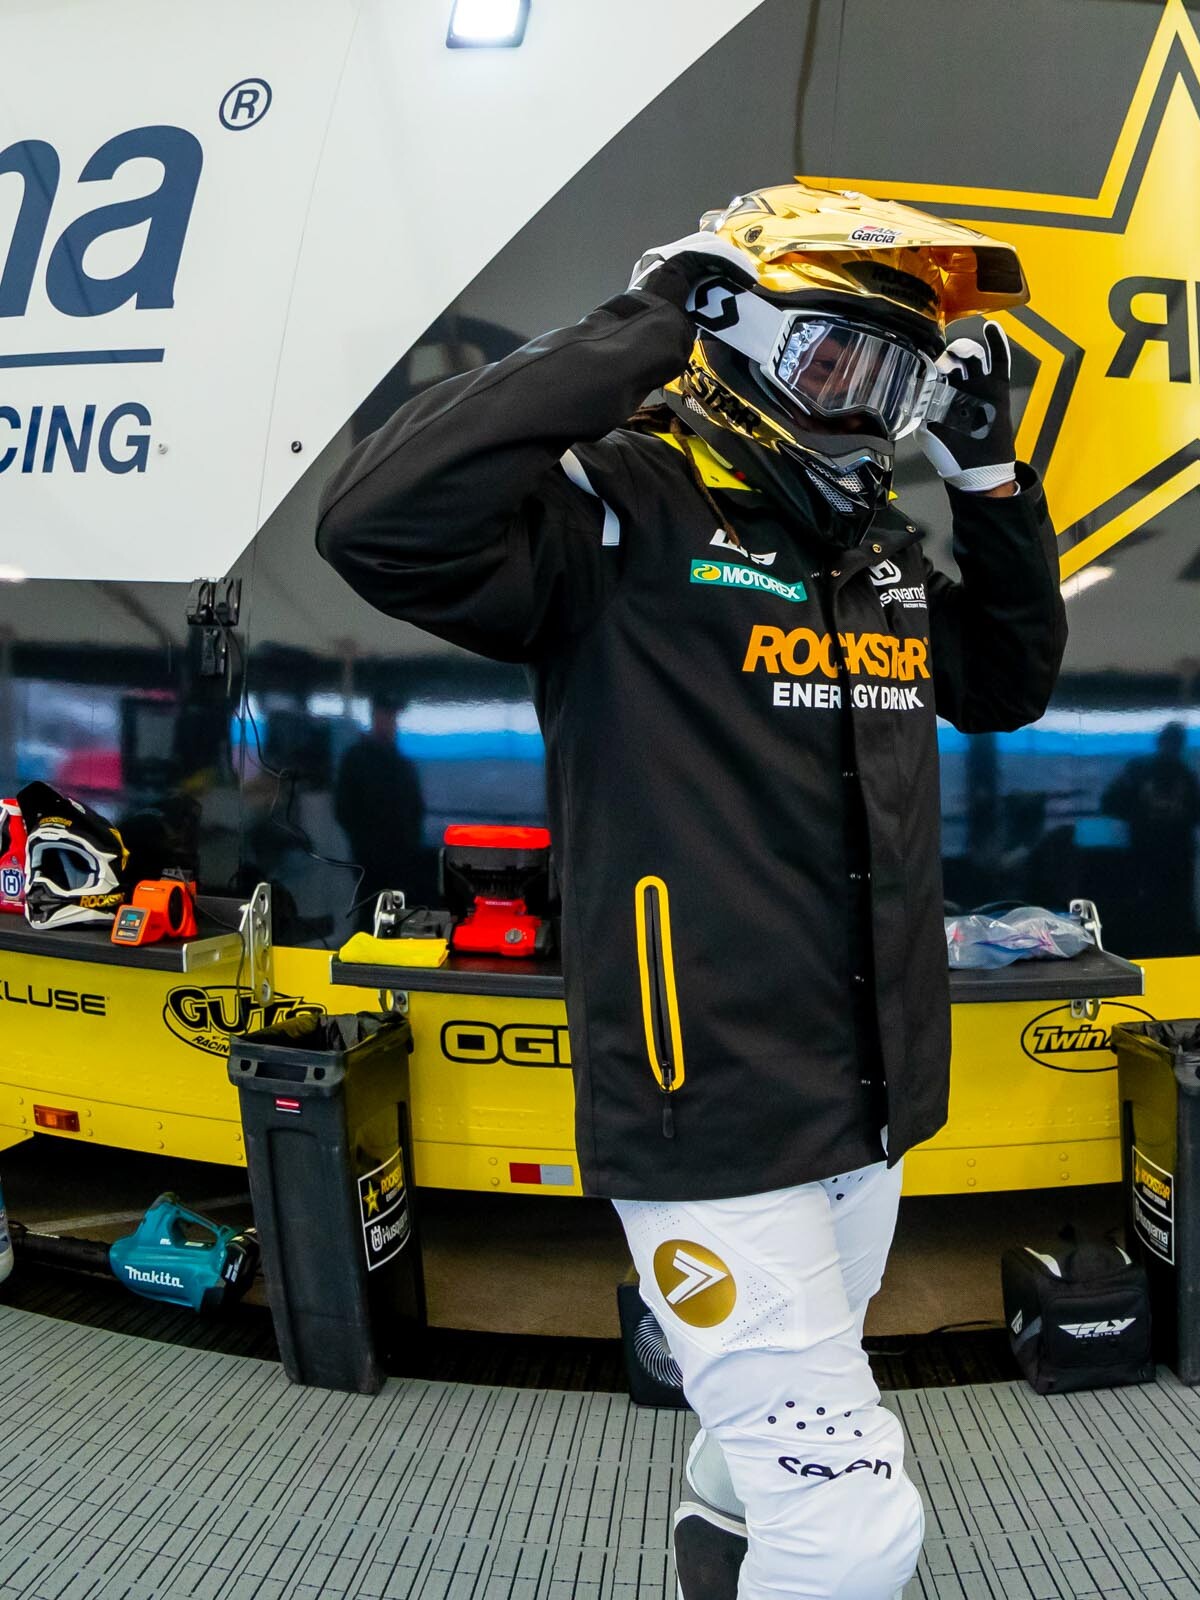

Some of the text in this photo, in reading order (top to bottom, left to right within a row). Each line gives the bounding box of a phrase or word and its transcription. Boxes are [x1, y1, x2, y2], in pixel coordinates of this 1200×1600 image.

[851, 230, 896, 244] Garcia
[723, 565, 800, 600] MOTOREX
[0, 979, 106, 1016] LUSE
[193, 1035, 230, 1053] RACIN
[440, 1020, 572, 1069] OGI
[1059, 1317, 1136, 1336] FLY
